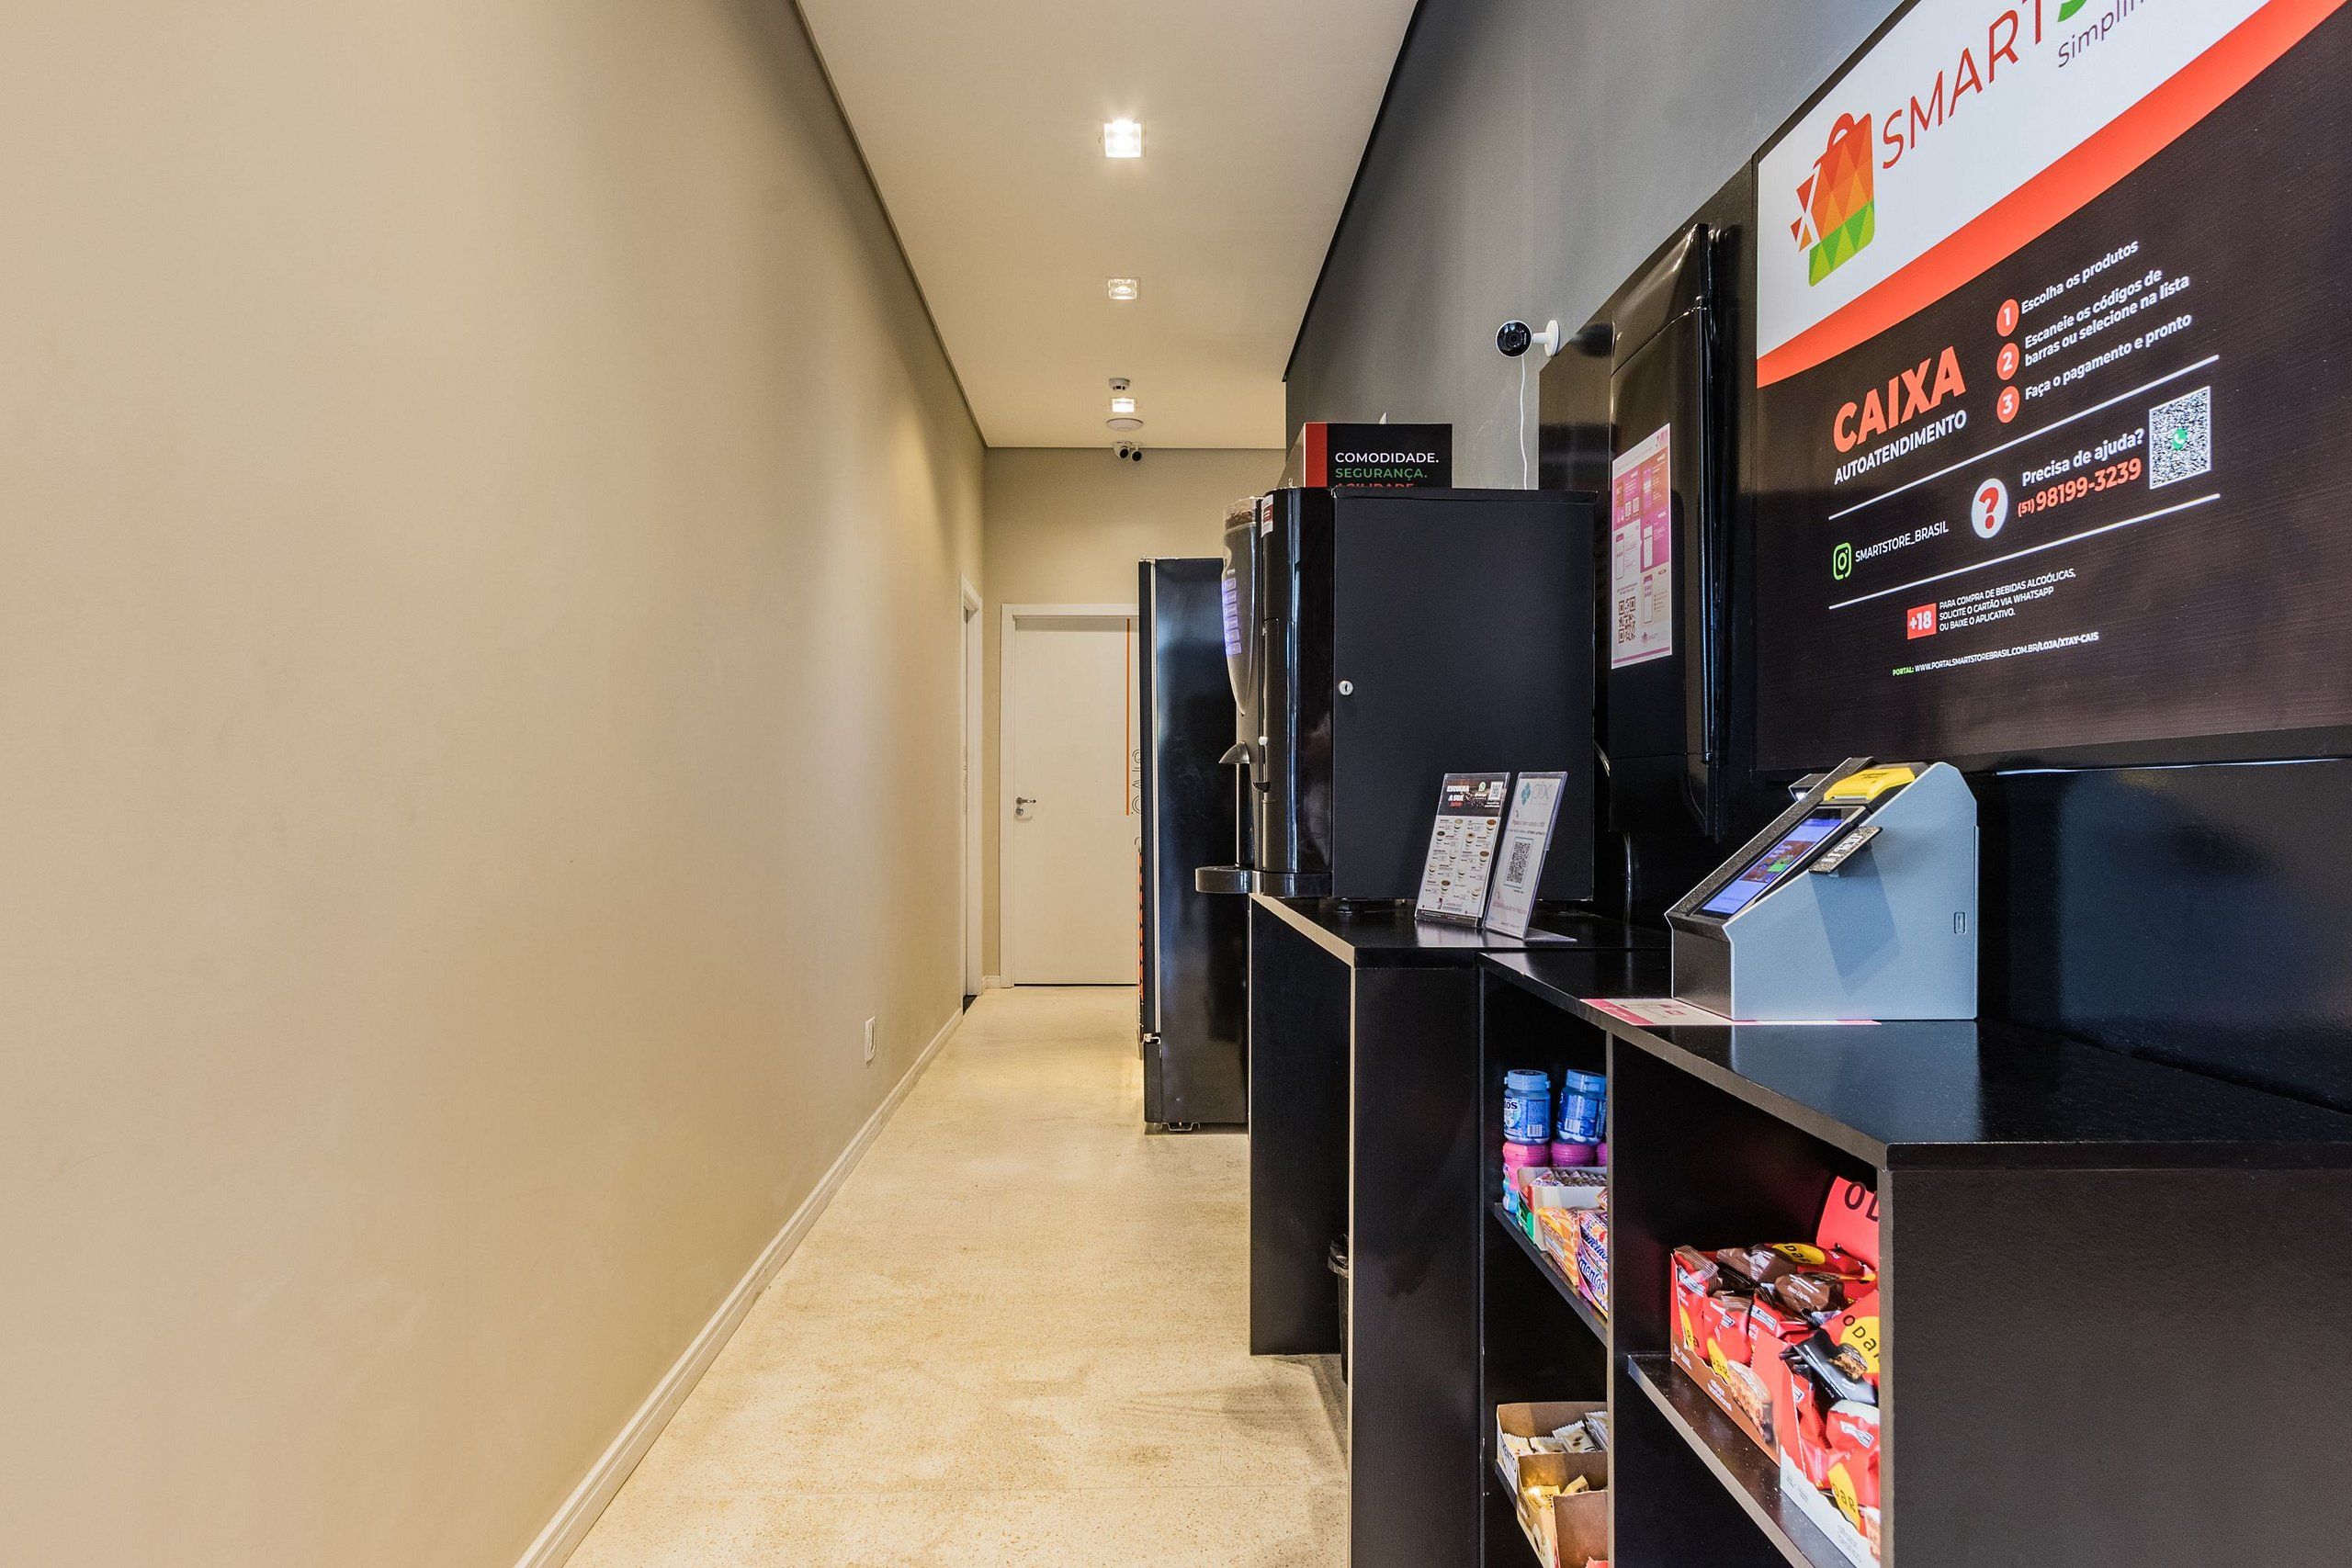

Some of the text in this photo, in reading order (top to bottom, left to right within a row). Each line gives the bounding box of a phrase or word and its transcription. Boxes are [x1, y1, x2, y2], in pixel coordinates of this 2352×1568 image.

[1883, 0, 2088, 169] SMART
[2003, 241, 2139, 326] 1 Escolha os produtos
[2002, 269, 2163, 372] 2 Escaneie os códigos de
[2025, 275, 2190, 367] barras ou selecione na lista
[2002, 313, 2192, 416] 3 Faça o pagamento e pronto
[1833, 345, 1966, 453] CAIXA
[1335, 452, 1440, 463] COMODIDADE.
[1335, 468, 1428, 481] SEGURANÇA.
[1834, 410, 1967, 485] AUTOATENDIMENTO
[2022, 428, 2145, 487] Precisa de ajuda?
[2018, 457, 2143, 518] (51) 98199-3239
[1855, 521, 1950, 562] SMARTSTORE_BRASIL
[1909, 586, 2054, 631] +18 SOLICITE O CARTÃO VIA WHATSAPP
[1939, 598, 1956, 610] PARA
[1956, 591, 1984, 607] COMPRA
[1984, 589, 1996, 599] DE
[1996, 581, 2027, 596] BEBIDAS
[1939, 607, 2016, 632] OU BAIXE O APLICATIVO.
[1892, 666, 1915, 677] PORTAL:
[1579, 1257, 1606, 1295] mentos
